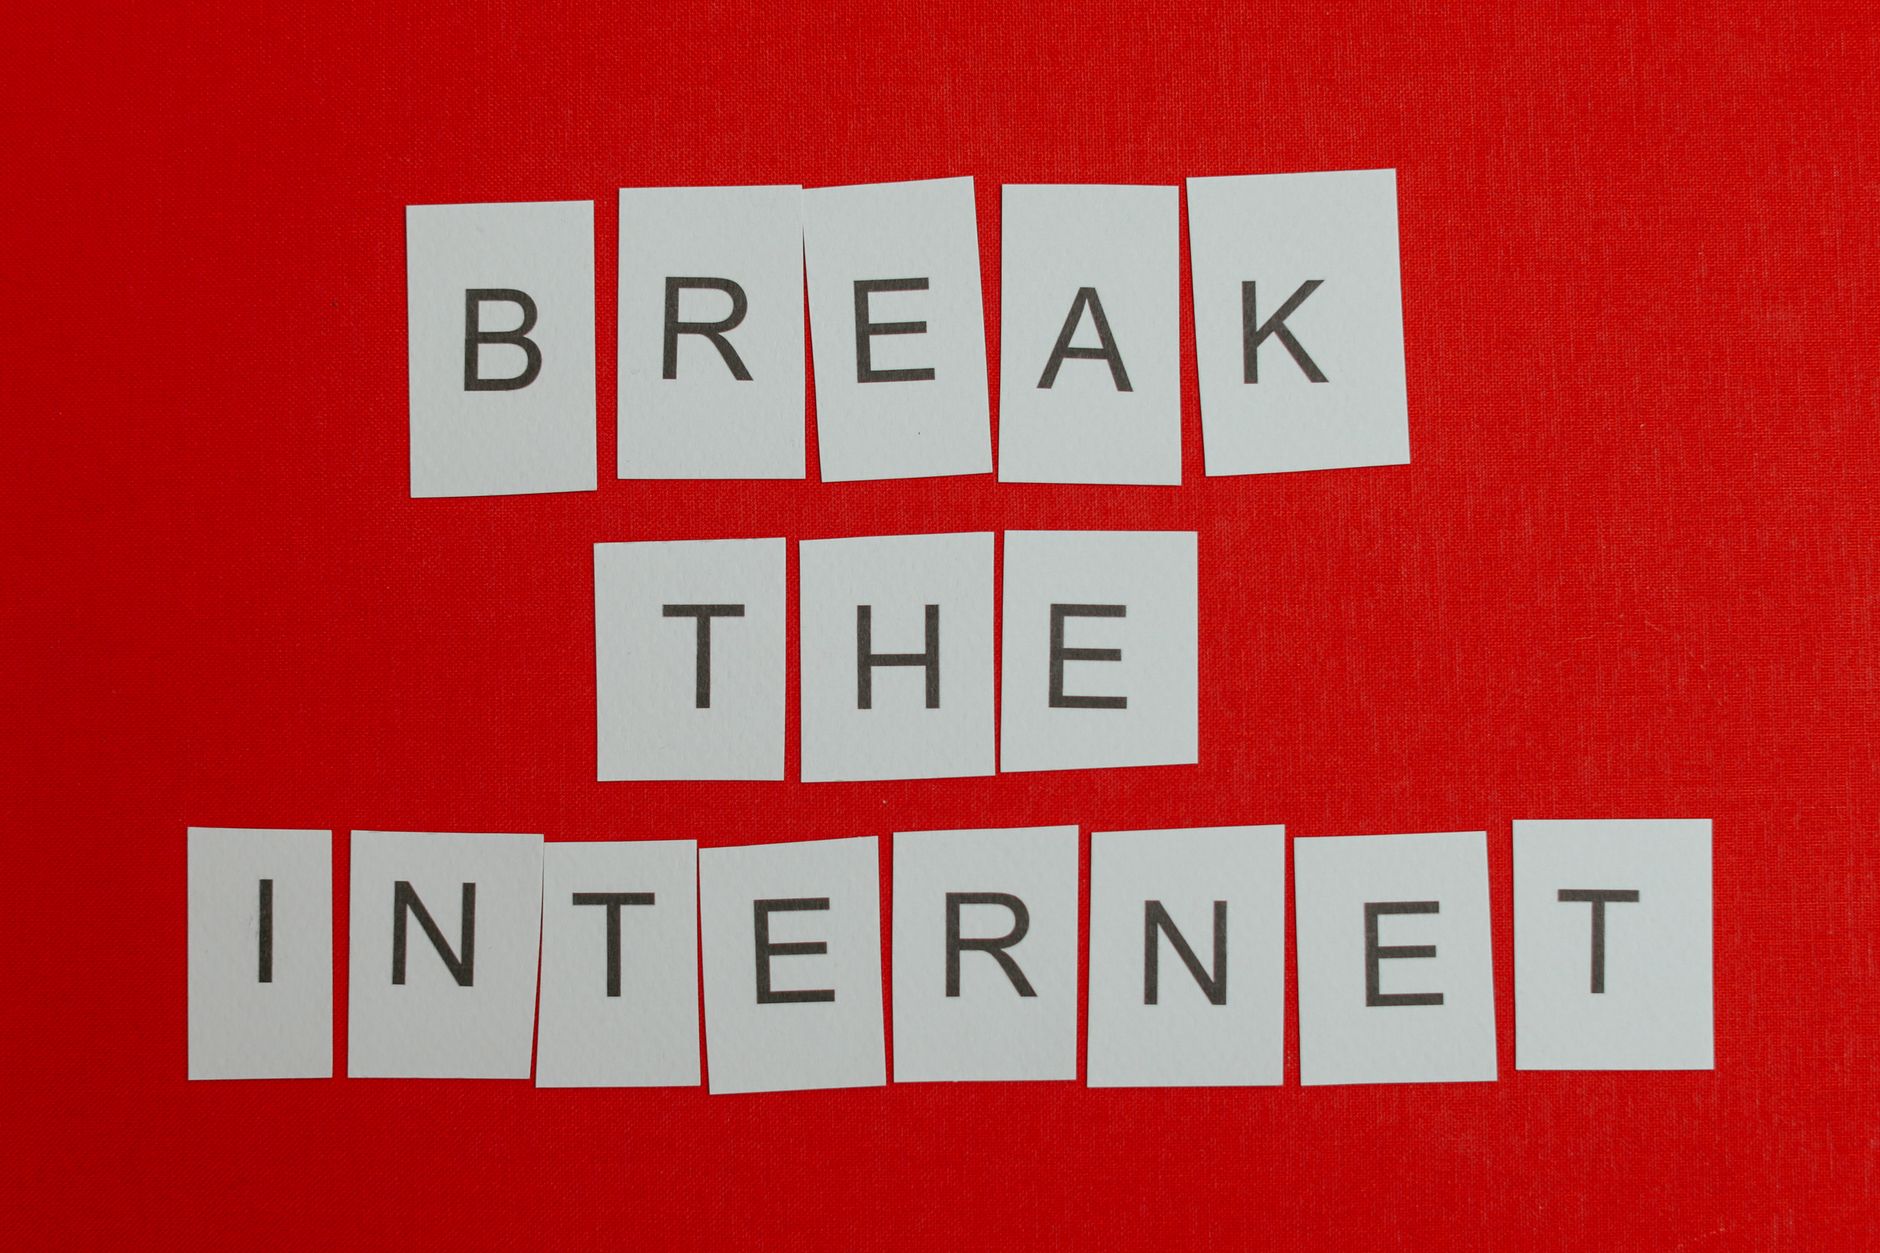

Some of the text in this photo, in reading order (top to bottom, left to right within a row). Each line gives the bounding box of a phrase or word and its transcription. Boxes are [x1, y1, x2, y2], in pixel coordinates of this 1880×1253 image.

[464, 276, 1330, 392] BREAK
[662, 603, 1128, 710] THE
[258, 878, 1640, 1008] INTERNET
